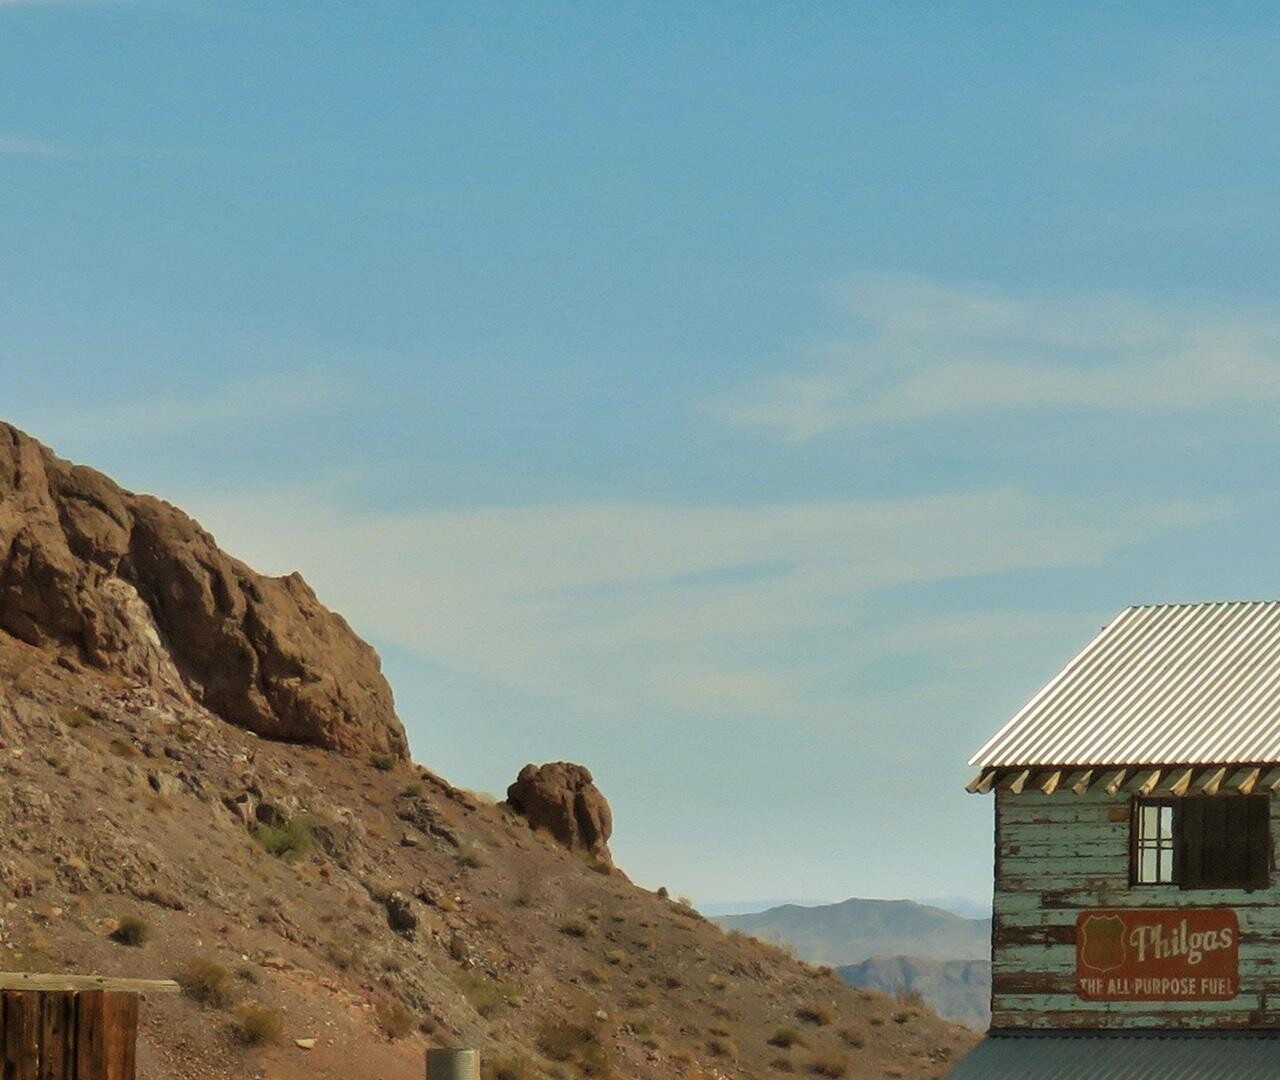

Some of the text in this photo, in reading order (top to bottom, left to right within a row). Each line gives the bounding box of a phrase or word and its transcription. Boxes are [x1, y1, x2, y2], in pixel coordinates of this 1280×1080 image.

[1129, 919, 1233, 965] Philgas
[1081, 978, 1103, 995] THE
[1201, 977, 1234, 995] FUEL
